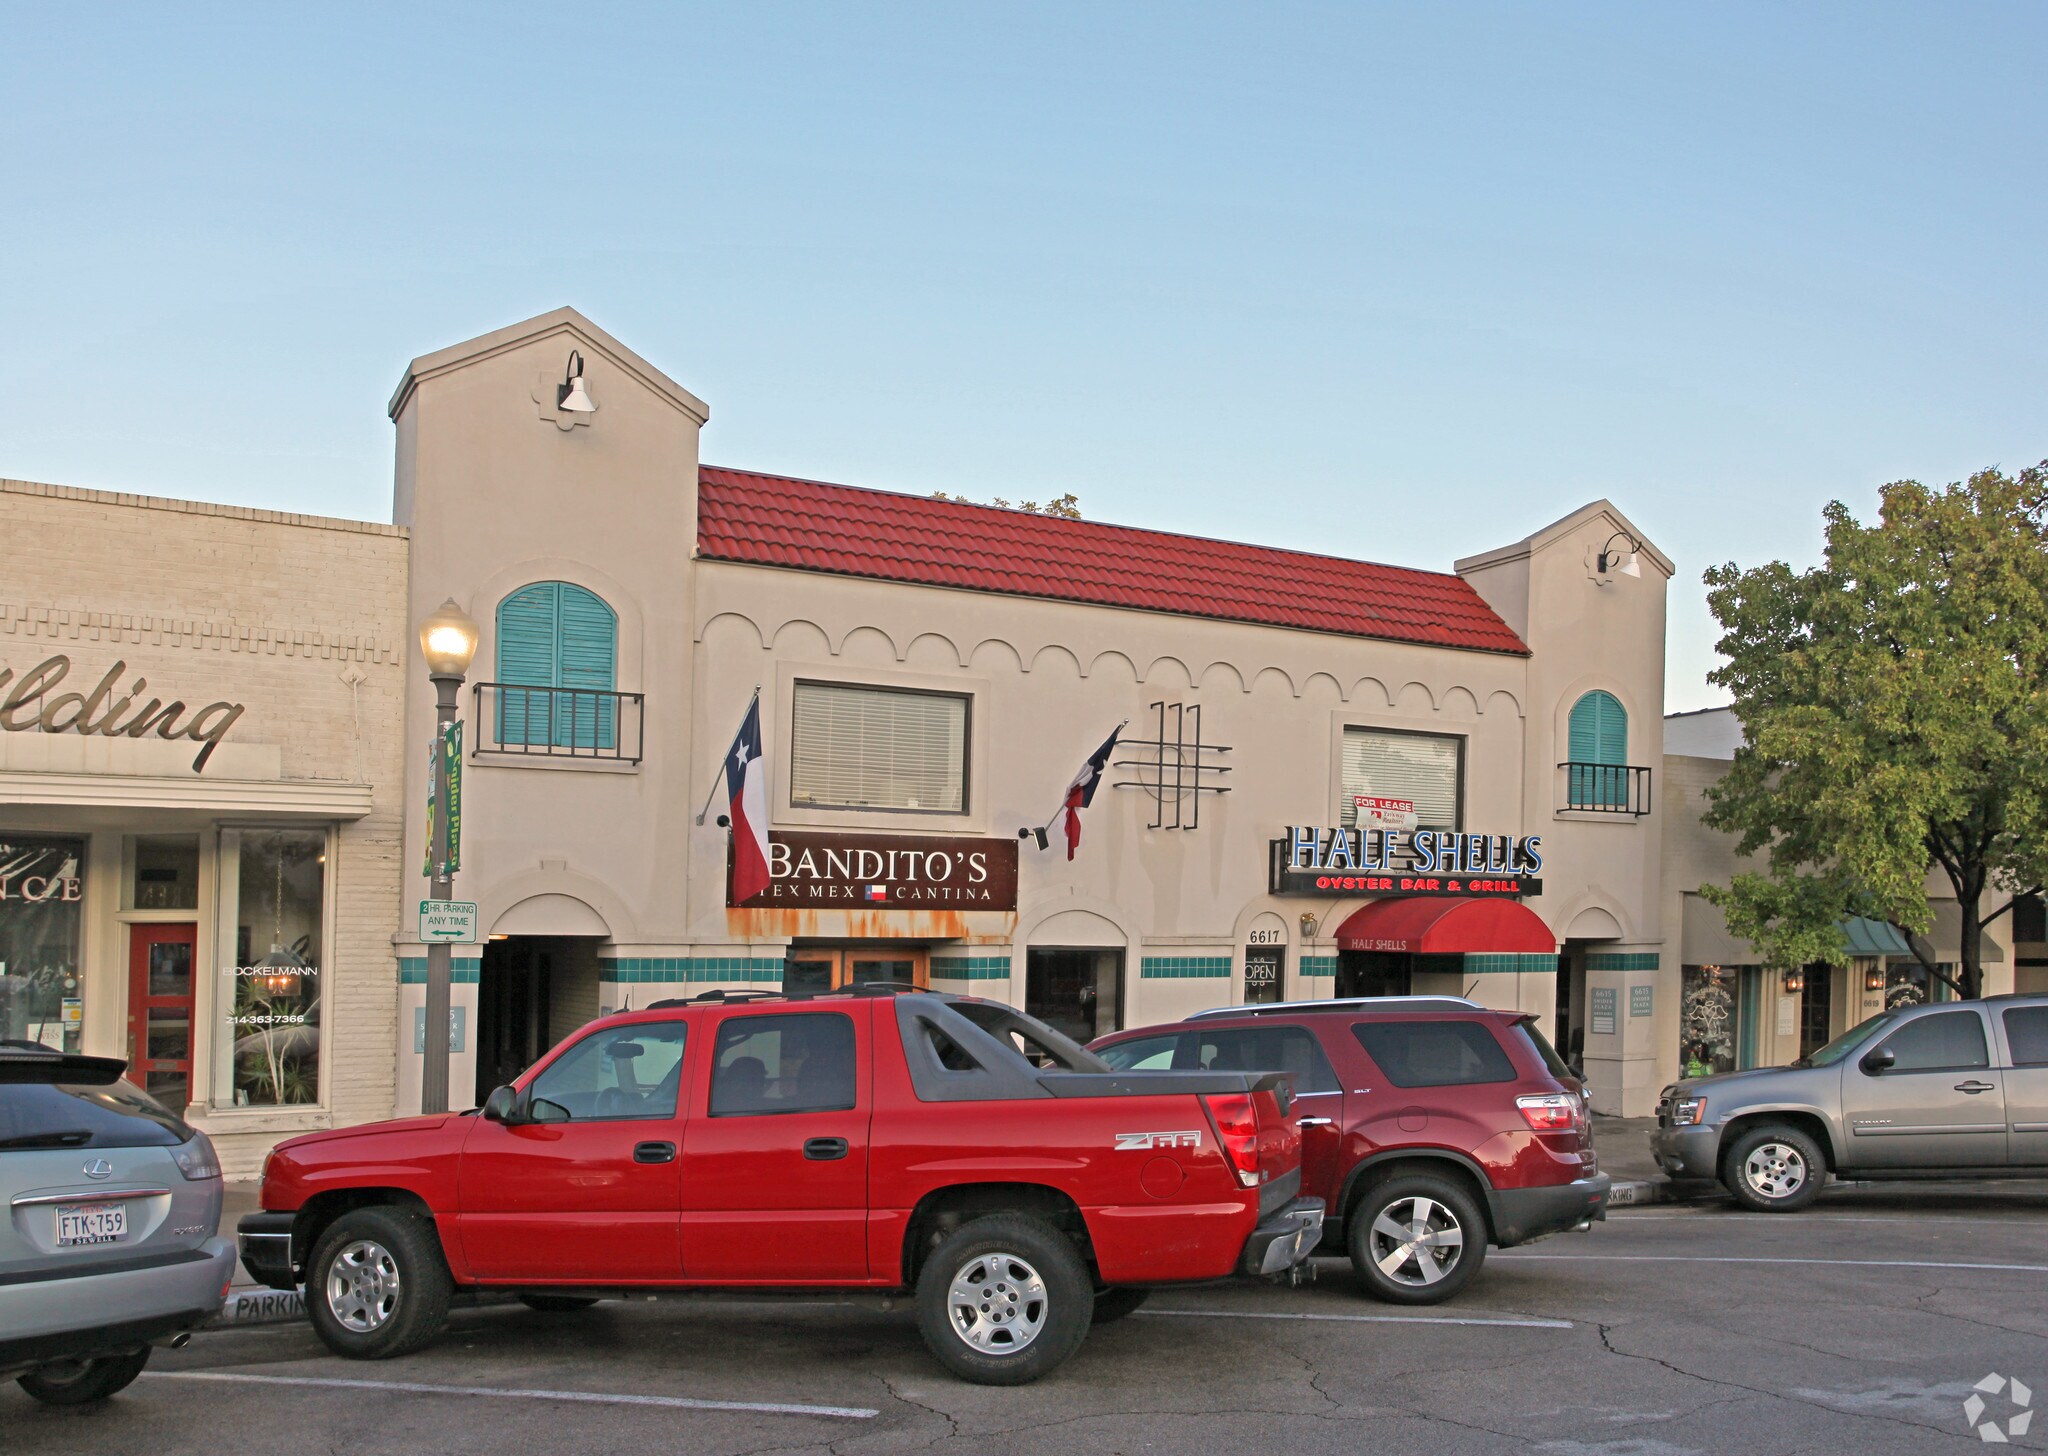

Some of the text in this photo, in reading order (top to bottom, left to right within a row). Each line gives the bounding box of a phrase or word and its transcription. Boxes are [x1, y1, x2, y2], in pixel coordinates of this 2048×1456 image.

[1355, 798, 1412, 811] FOR LEASE
[450, 815, 460, 867] Plaza
[1287, 826, 1544, 875] HALF SHELLS
[768, 843, 987, 882] BANDITO'S
[1316, 876, 1520, 892] OYSTER BAR & GRILL
[810, 885, 854, 898] MEX
[896, 887, 990, 900] CANTINA
[423, 904, 428, 912] 2
[443, 905, 474, 914] PARKING
[428, 917, 469, 925] ANY TIME
[1250, 930, 1279, 943] 6617
[1351, 938, 1407, 950] HALF SHELLS
[222, 966, 318, 976] BOCKELMANN
[1245, 965, 1275, 979] OPEN
[1595, 990, 1612, 998] 6615
[1635, 987, 1649, 995] 6615
[226, 1016, 304, 1024] 214-363-7366
[1609, 1188, 1632, 1202] RKING
[76, 1236, 114, 1245] SEWELL
[236, 1294, 308, 1318] PARKIN
